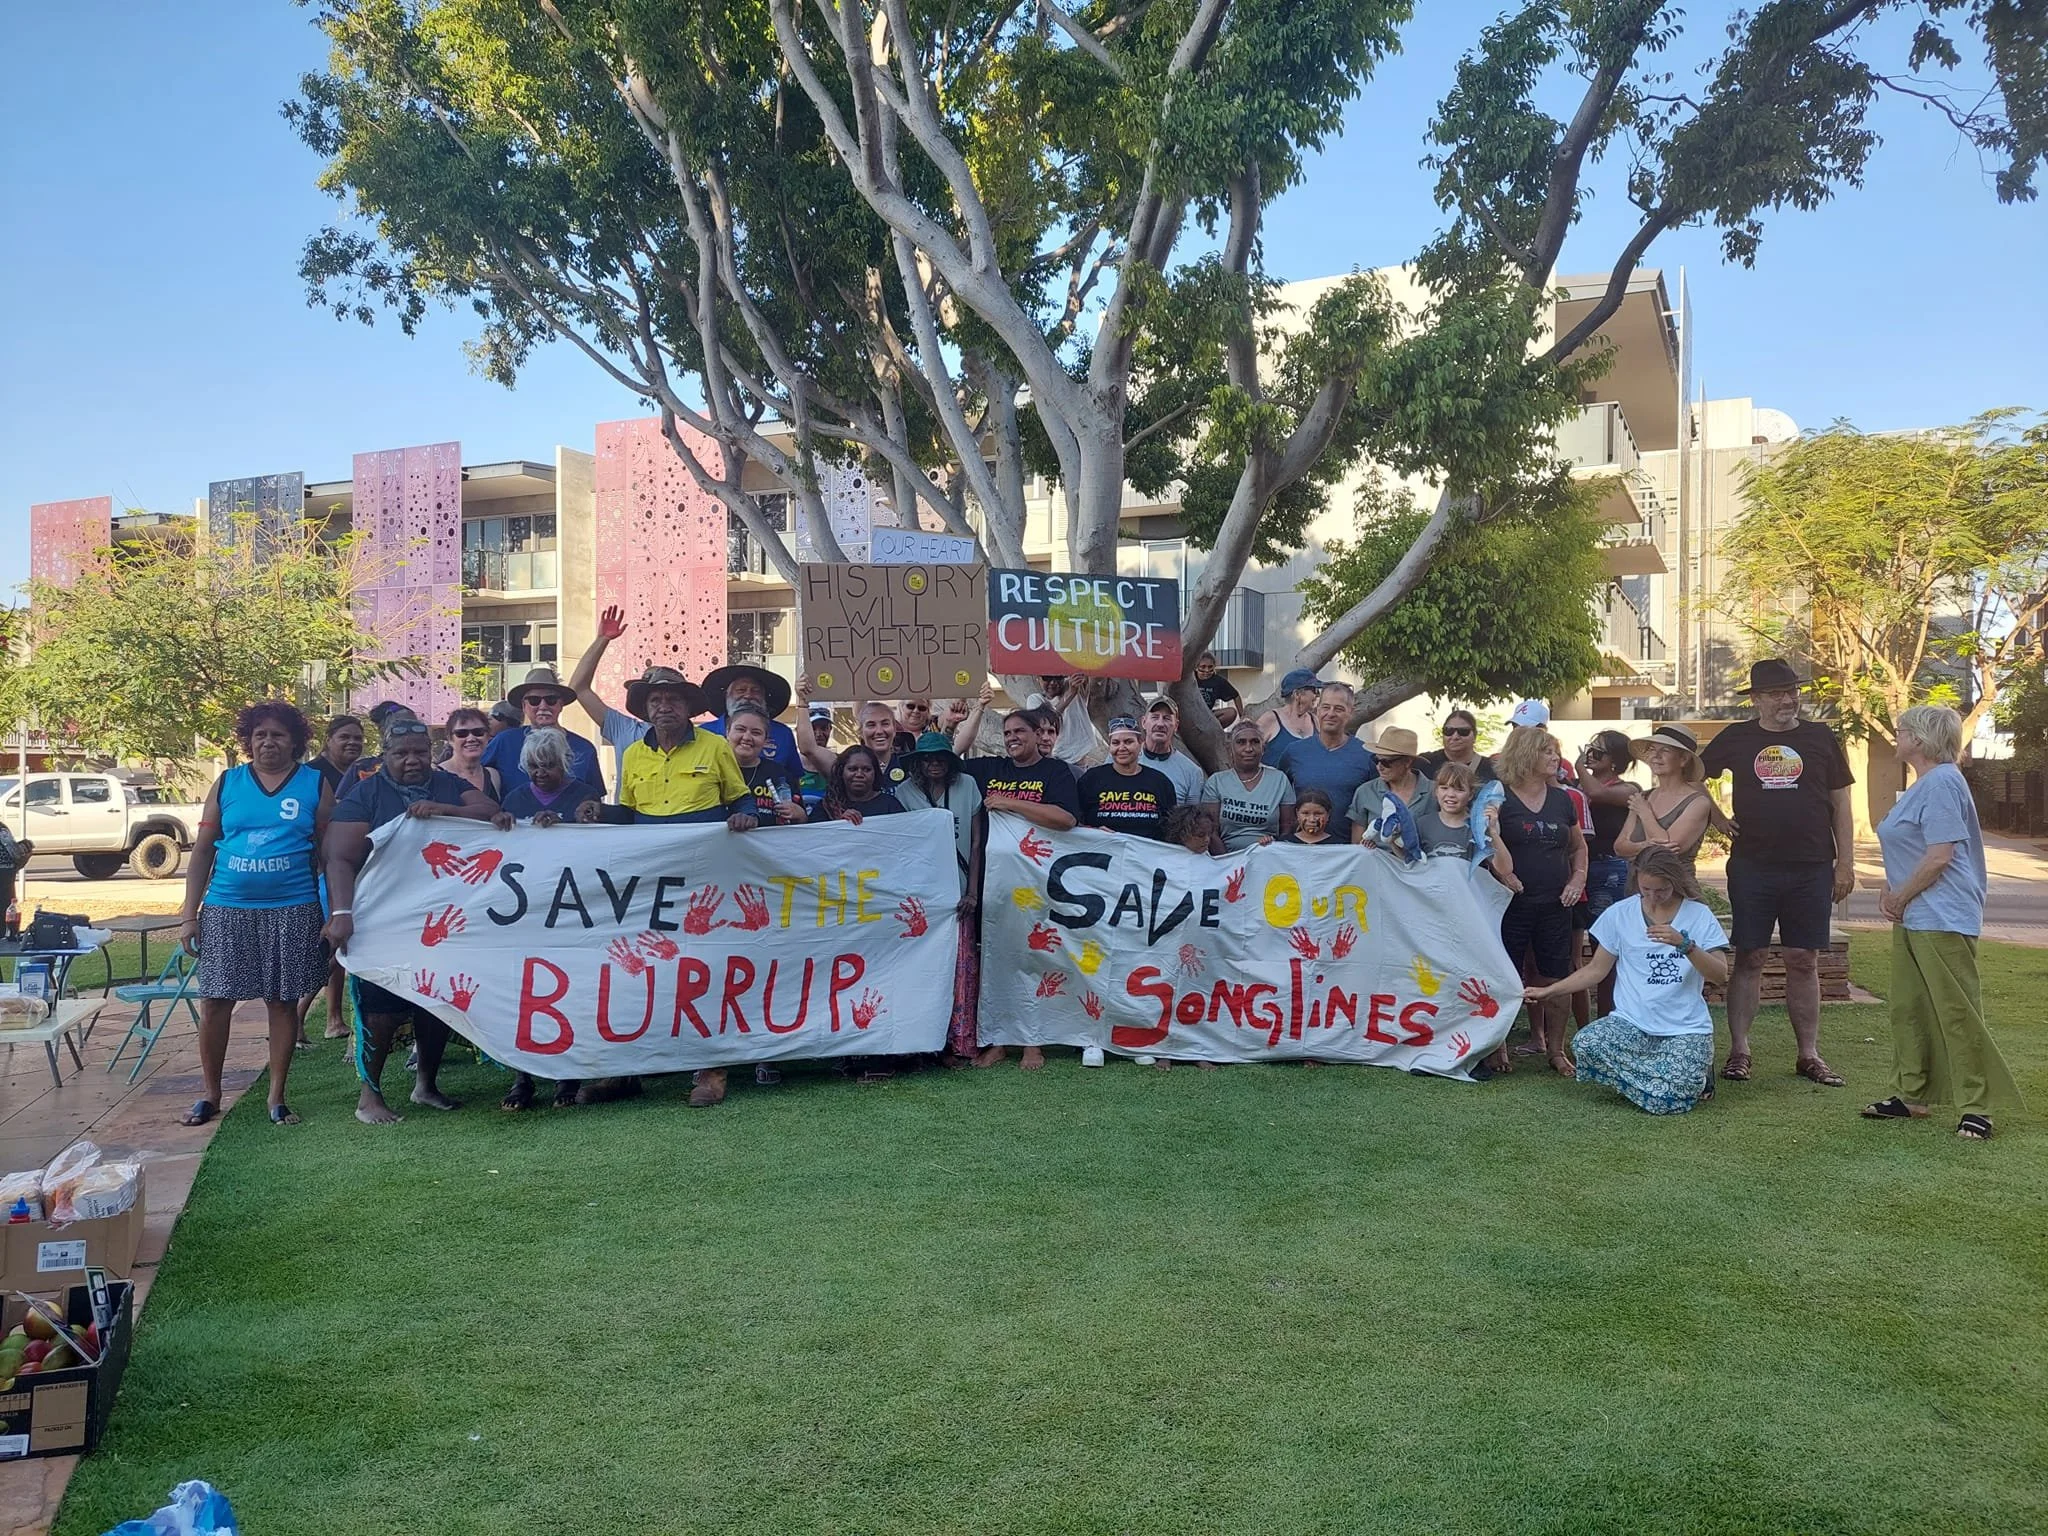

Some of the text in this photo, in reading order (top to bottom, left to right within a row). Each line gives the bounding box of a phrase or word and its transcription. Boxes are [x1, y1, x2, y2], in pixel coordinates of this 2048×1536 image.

[881, 535, 973, 561] OUR HEART
[808, 564, 985, 602] HISTORY
[1000, 573, 1160, 611] RESPECT
[841, 596, 934, 628] WILL
[806, 622, 981, 662] REMEMBER
[998, 613, 1164, 660] CULTURE
[843, 655, 933, 696] YOU
[987, 779, 1044, 792] SAVE OUR
[1099, 791, 1157, 804] SAVE OUR
[279, 798, 299, 820] 9
[1222, 797, 1270, 811] SAVE THE
[1222, 810, 1267, 825] BURRUP
[227, 855, 291, 873] BREAKERS
[486, 862, 882, 932] SAVE THE
[1045, 852, 1369, 946] SAVE OUR
[515, 953, 865, 1055] BURRUP
